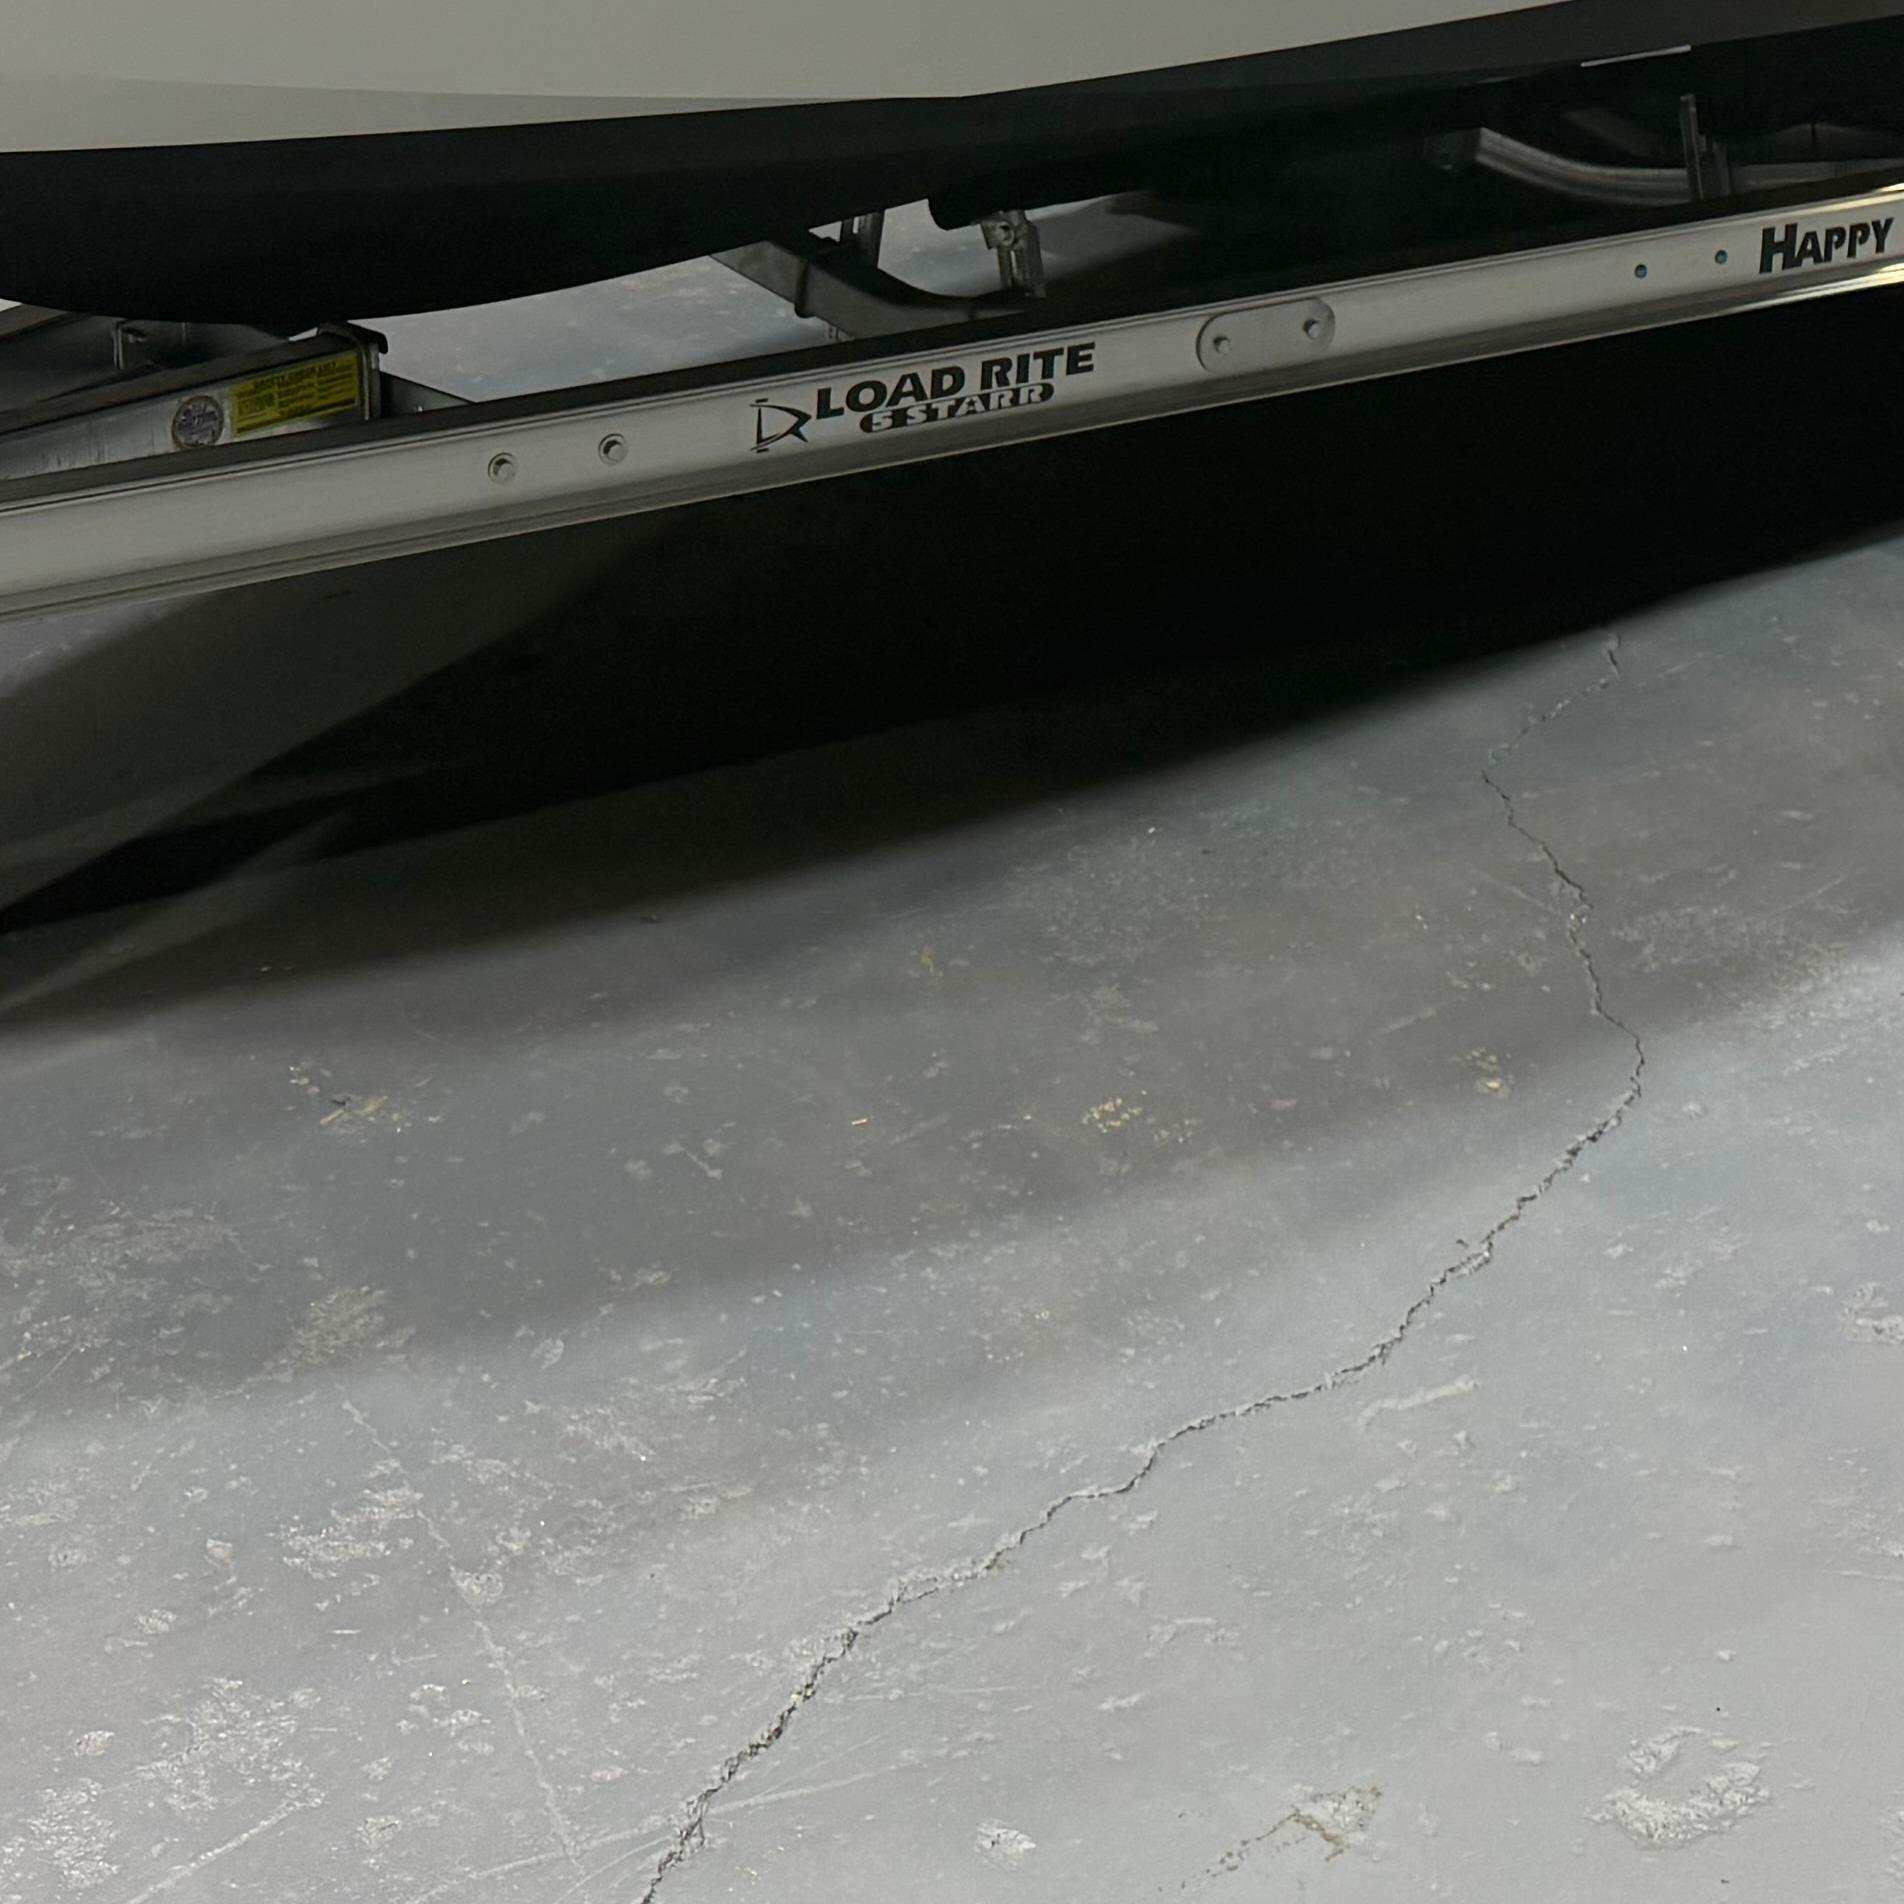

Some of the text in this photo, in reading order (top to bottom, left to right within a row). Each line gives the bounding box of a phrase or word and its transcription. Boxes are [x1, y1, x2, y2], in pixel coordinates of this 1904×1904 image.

[1759, 217, 1894, 274] HAPPY
[815, 341, 1096, 420] LOAD RITE
[906, 383, 1045, 425] STARR
